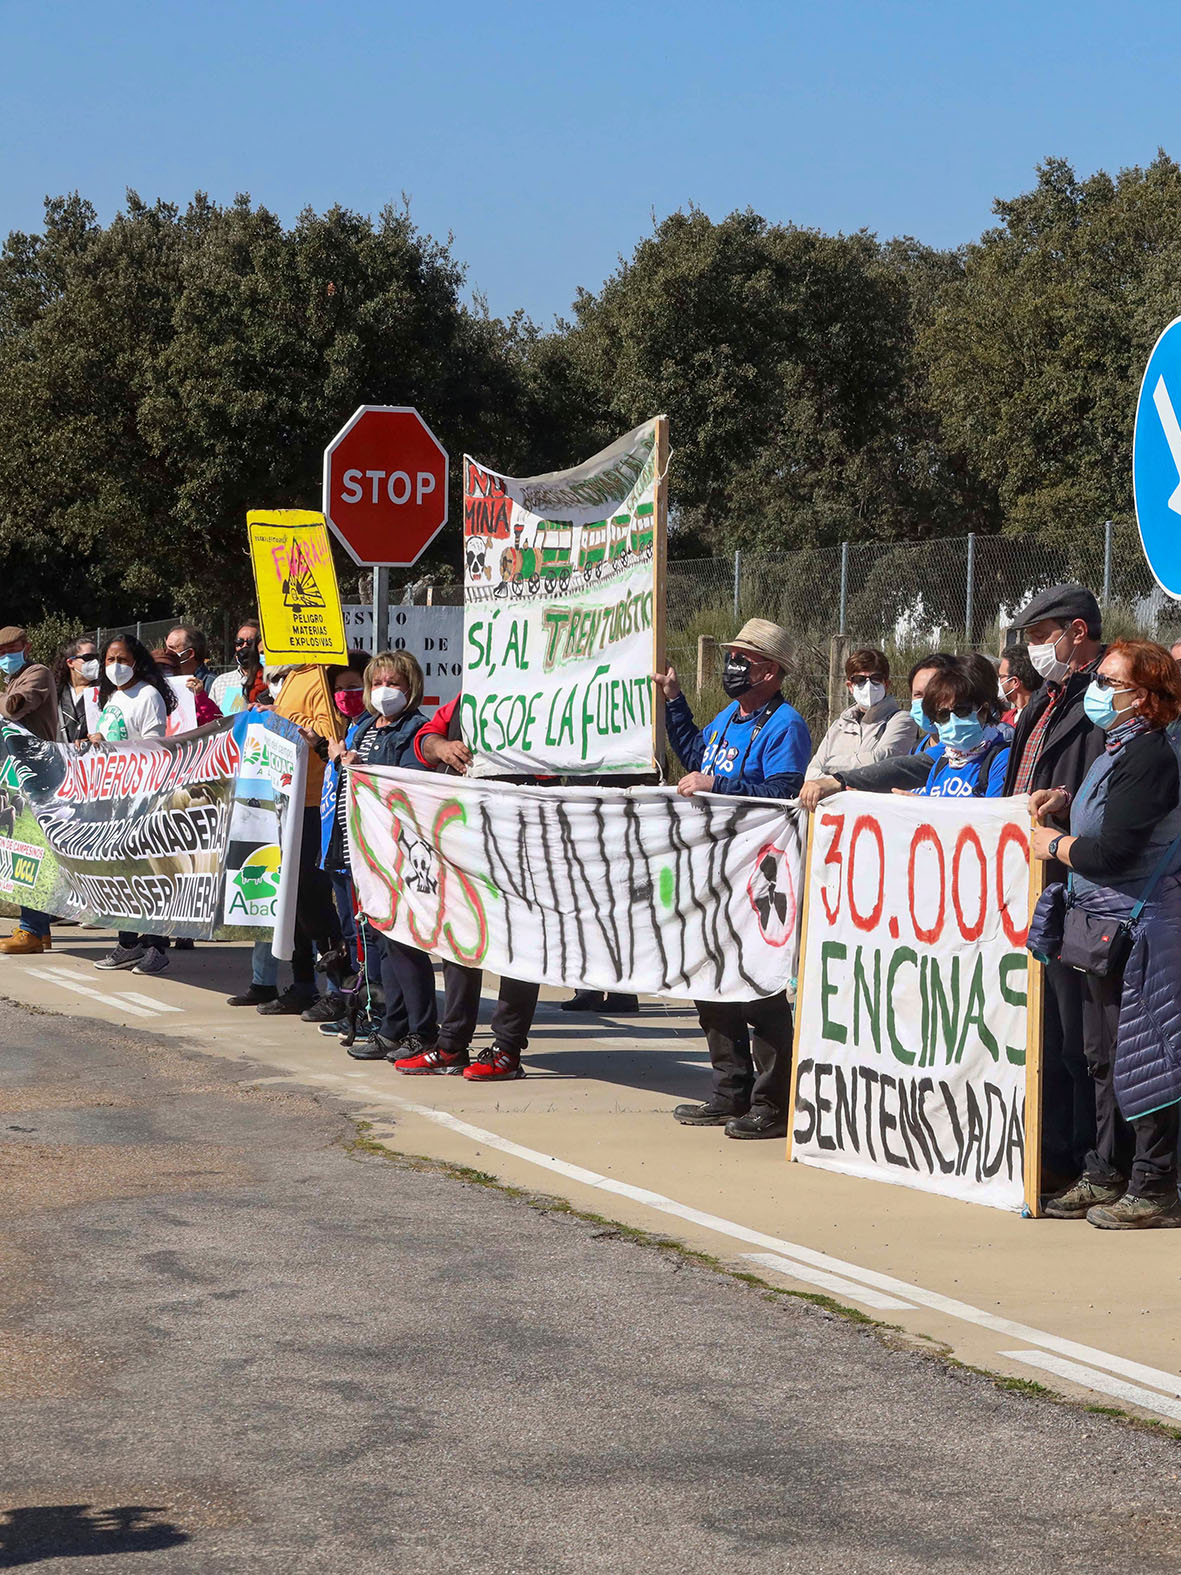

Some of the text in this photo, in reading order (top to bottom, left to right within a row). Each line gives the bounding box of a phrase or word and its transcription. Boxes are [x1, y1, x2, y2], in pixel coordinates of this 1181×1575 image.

[340, 469, 436, 504] STOP
[465, 500, 511, 535] MINA
[292, 625, 328, 636] MATERIAS
[293, 613, 324, 624] PELIGRO
[502, 619, 529, 670] AL
[543, 606, 600, 669] TREN
[599, 588, 653, 650] TURÍSTIC
[289, 636, 333, 647] EXPLOSIVAS
[424, 637, 449, 651] DE
[425, 662, 463, 677] INO
[460, 691, 544, 755] DESDE
[545, 683, 579, 747] LA
[56, 751, 148, 803] GANADEROS
[14, 858, 36, 882] UCCL
[820, 813, 1030, 947] 30.000
[132, 874, 175, 921] SER
[171, 872, 220, 923] MINERA
[820, 941, 1029, 1067] ENCINAS
[793, 1057, 1027, 1183] SENTENCIADA
